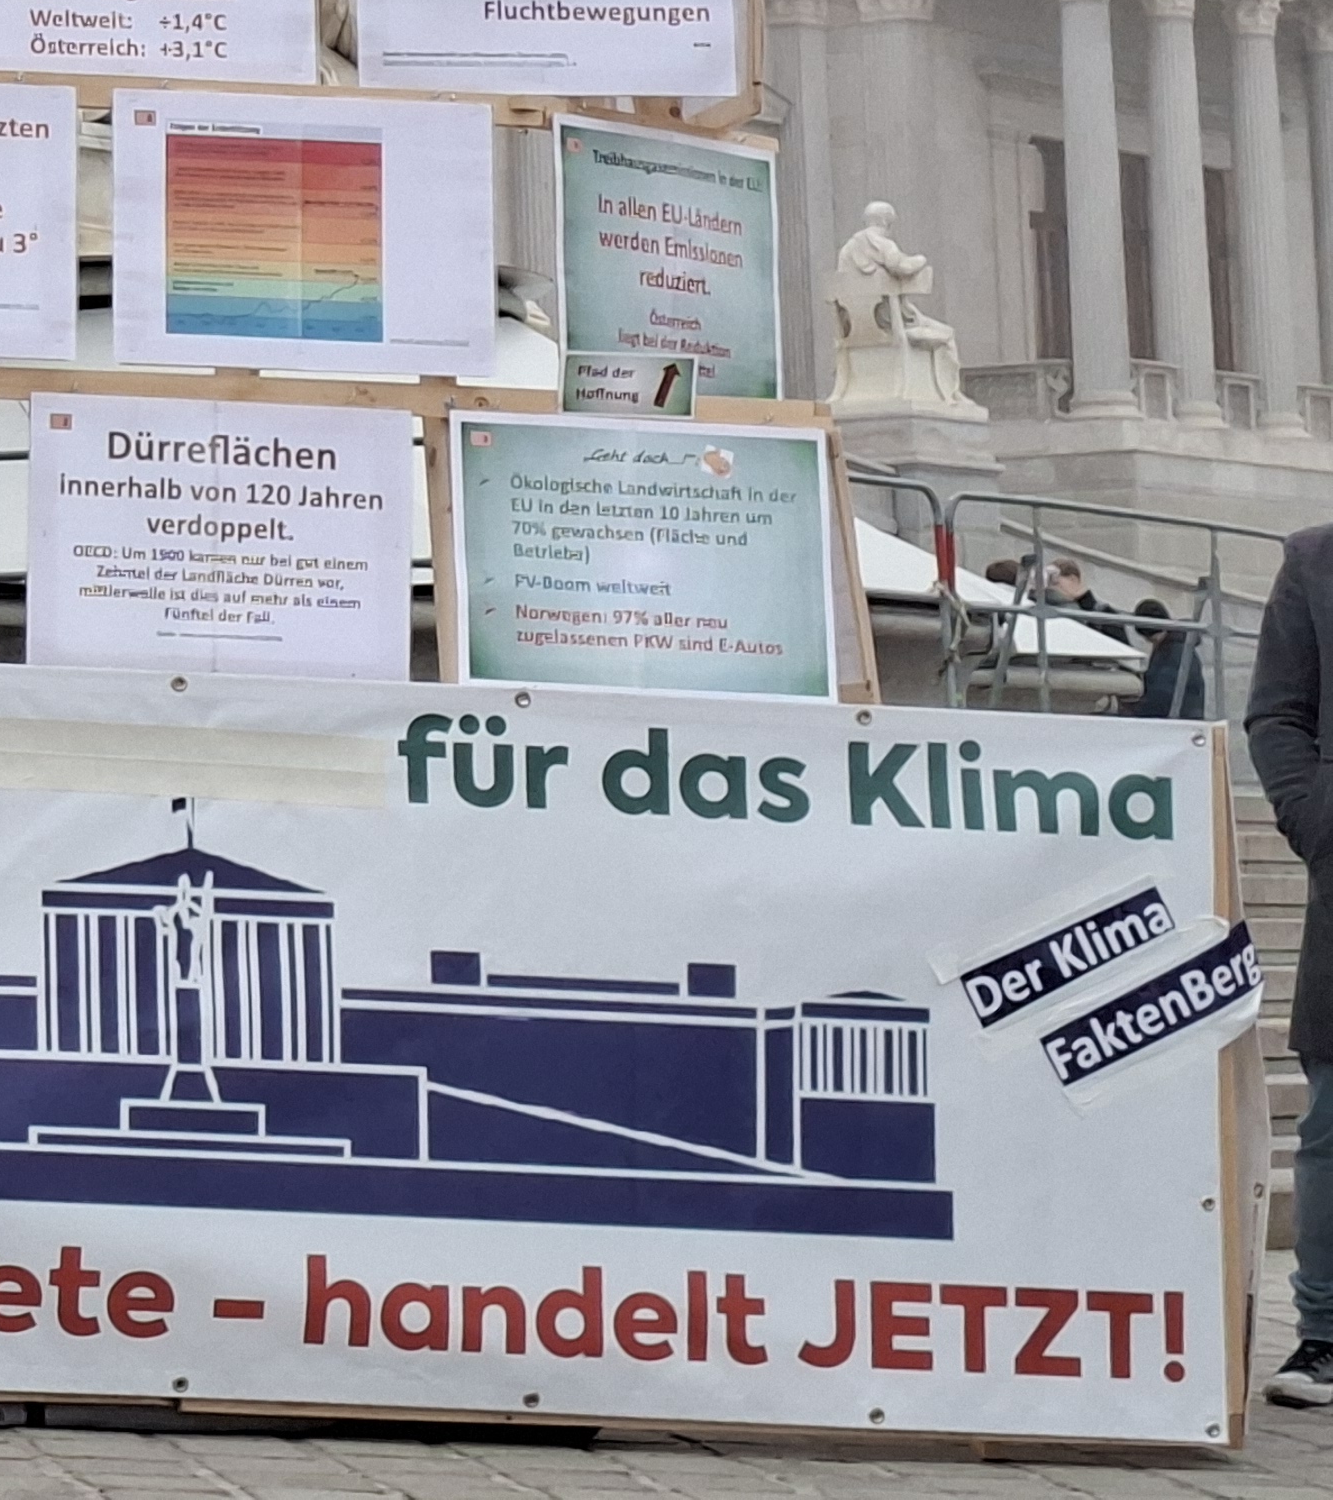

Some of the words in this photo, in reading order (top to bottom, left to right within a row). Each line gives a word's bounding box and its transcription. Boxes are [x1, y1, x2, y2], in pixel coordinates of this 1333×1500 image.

[30, 9, 133, 29] Weltweit:
[484, 1, 710, 26] Fluchtbewegungen
[30, 33, 146, 57] Österreich:
[160, 40, 228, 61] +3,1°C
[598, 194, 613, 215] In
[618, 197, 657, 220] allen
[662, 202, 742, 236] EU-Ländern
[13, 231, 39, 254] 3°
[599, 231, 660, 255] werden
[665, 236, 743, 268] Emissionen
[639, 268, 711, 295] reduziert.
[108, 431, 337, 470] Dürreflächen
[60, 473, 182, 500] innerhalb
[190, 483, 236, 504] von
[246, 482, 291, 506] 120
[298, 485, 384, 510] Jahren
[510, 472, 613, 496] Ökologische
[511, 497, 533, 513] EU
[660, 506, 680, 521] 10
[147, 513, 294, 544] verdoppelt.
[716, 531, 748, 547] und
[122, 546, 146, 560] Um
[613, 610, 649, 627] 97%
[517, 628, 628, 647] zugelassenen
[634, 633, 674, 649] PKW
[679, 635, 713, 652] sind
[397, 713, 570, 811] für
[601, 727, 811, 824] das
[847, 739, 1175, 841] Klima
[967, 959, 1044, 1019] Der
[1049, 902, 1173, 976] Klima
[1045, 944, 1262, 1080] FaktenBerg
[303, 1253, 769, 1365] handelt
[797, 1279, 1186, 1384] JETZT!
